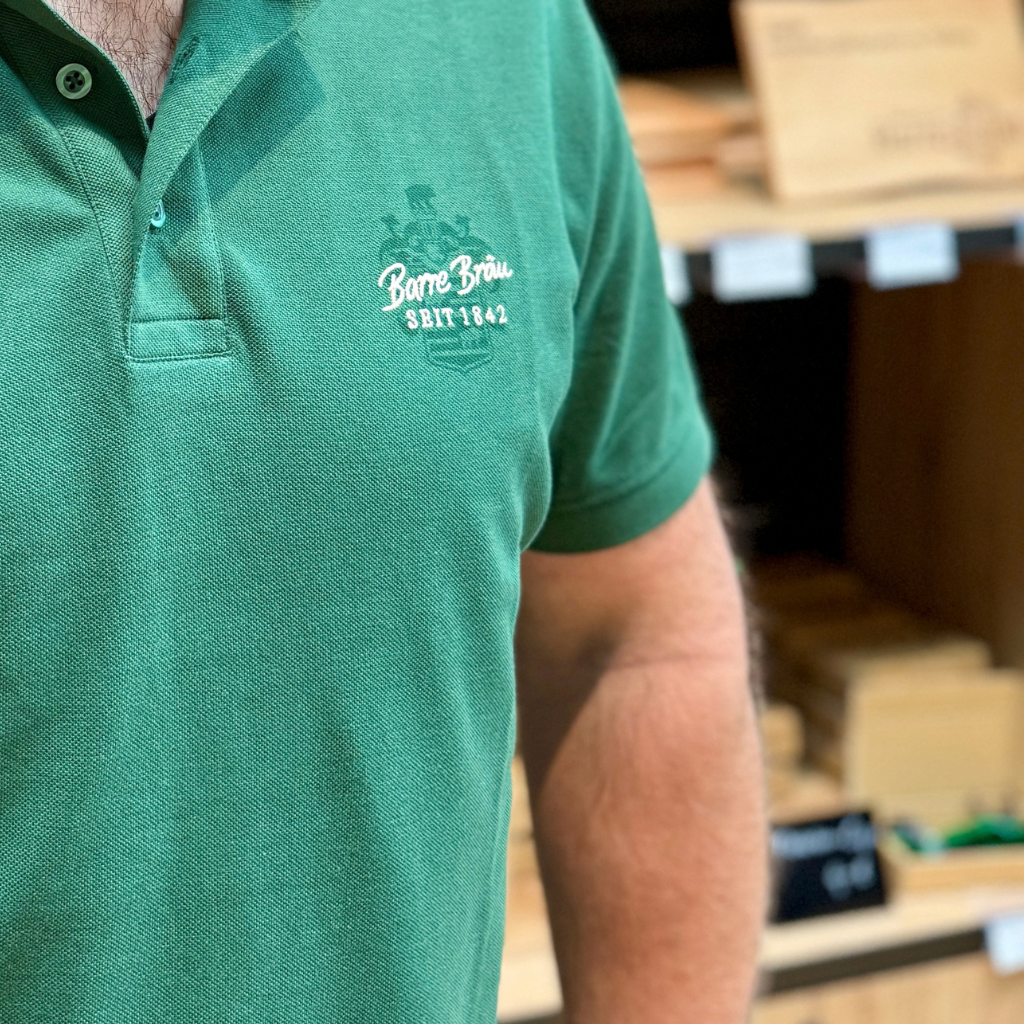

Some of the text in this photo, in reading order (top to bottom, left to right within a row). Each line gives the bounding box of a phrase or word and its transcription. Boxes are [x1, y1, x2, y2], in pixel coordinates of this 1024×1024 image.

[378, 254, 513, 312] Barre Bräu
[405, 304, 508, 330] SEIT 1842
